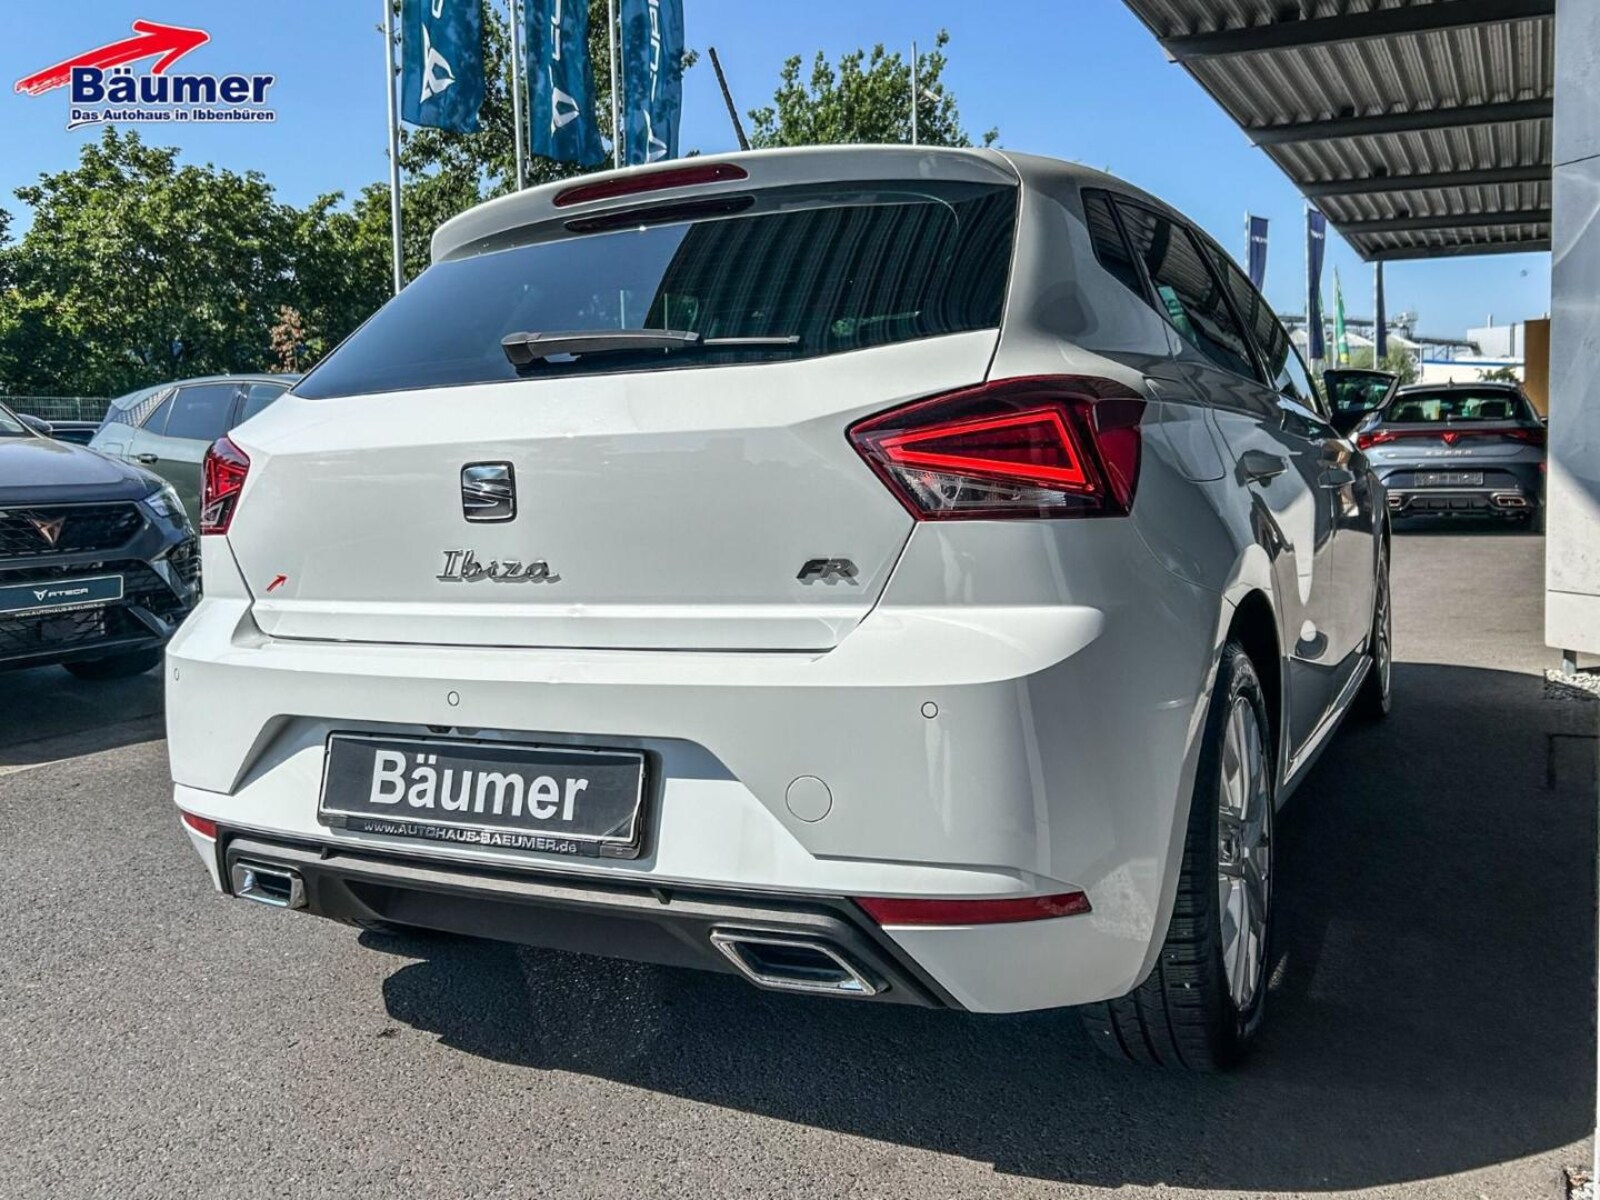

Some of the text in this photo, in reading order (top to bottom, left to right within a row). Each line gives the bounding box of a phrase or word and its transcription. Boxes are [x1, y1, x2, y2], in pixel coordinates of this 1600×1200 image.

[436, 549, 562, 583] Ibiza
[796, 558, 859, 583] FR
[370, 750, 589, 821] Bäumer
